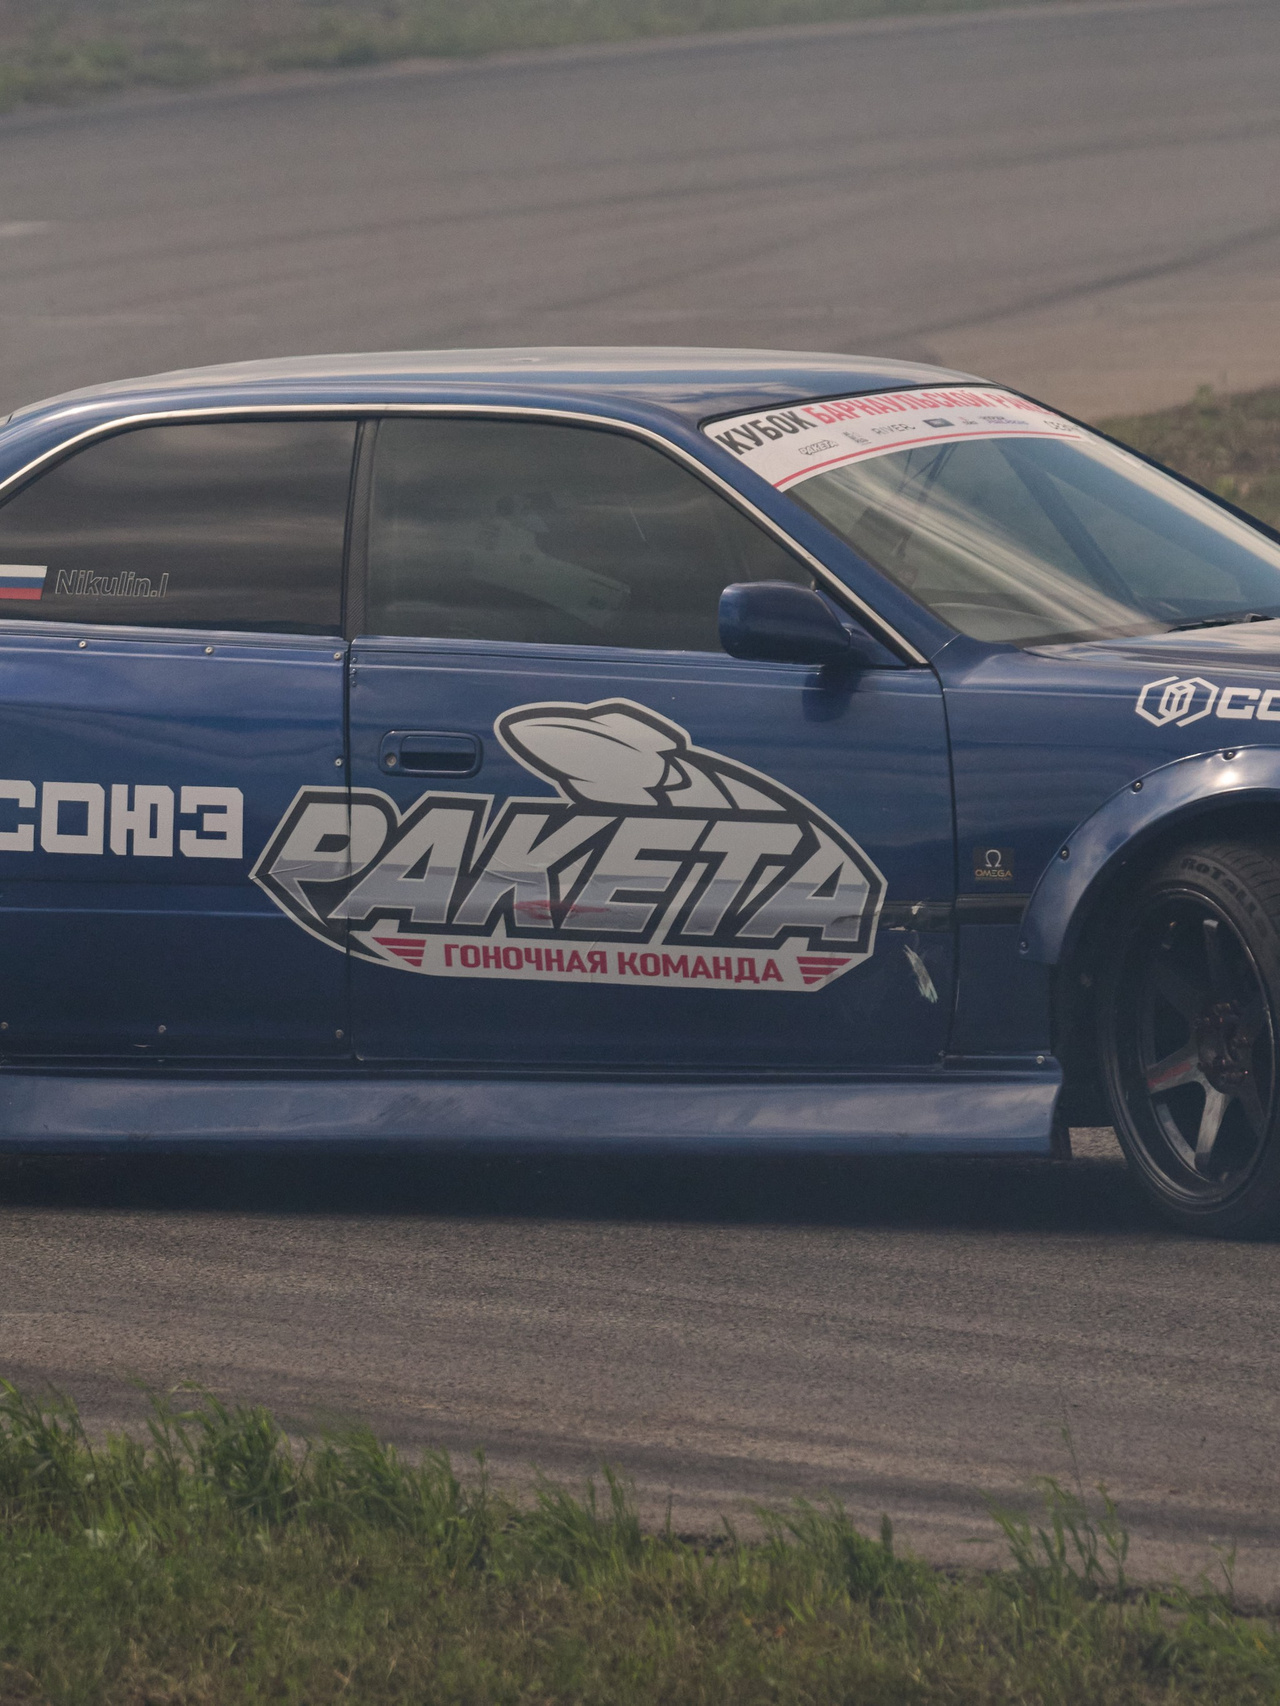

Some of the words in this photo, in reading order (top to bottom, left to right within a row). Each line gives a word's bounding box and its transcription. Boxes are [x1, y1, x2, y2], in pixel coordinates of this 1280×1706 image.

[715, 410, 818, 455] КУБОК
[264, 792, 882, 949] РАКЕТА
[975, 869, 1013, 877] OMEGA
[444, 943, 607, 974] ГОНОЧНАЯ
[618, 951, 783, 983] КОМАНДА
